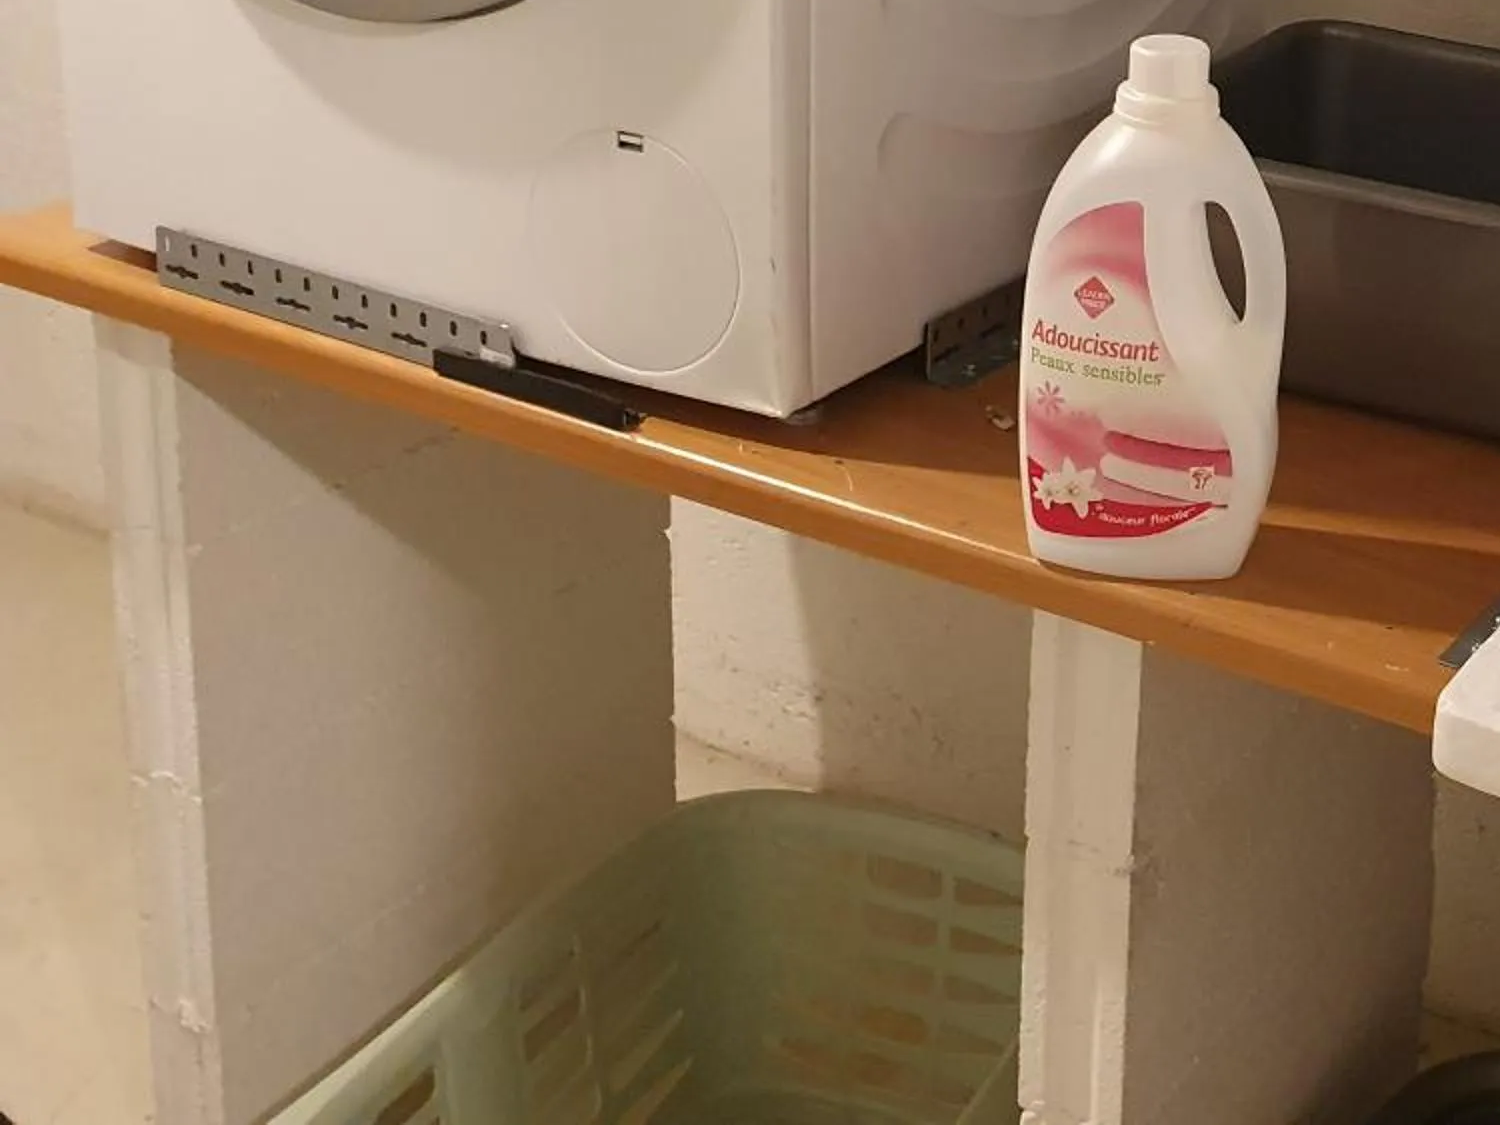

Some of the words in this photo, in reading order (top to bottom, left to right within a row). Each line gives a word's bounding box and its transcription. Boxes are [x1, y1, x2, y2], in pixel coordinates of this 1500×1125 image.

[1031, 318, 1160, 363] Adoucissant
[1031, 346, 1075, 374] Peaux
[1081, 364, 1165, 387] sensibles
